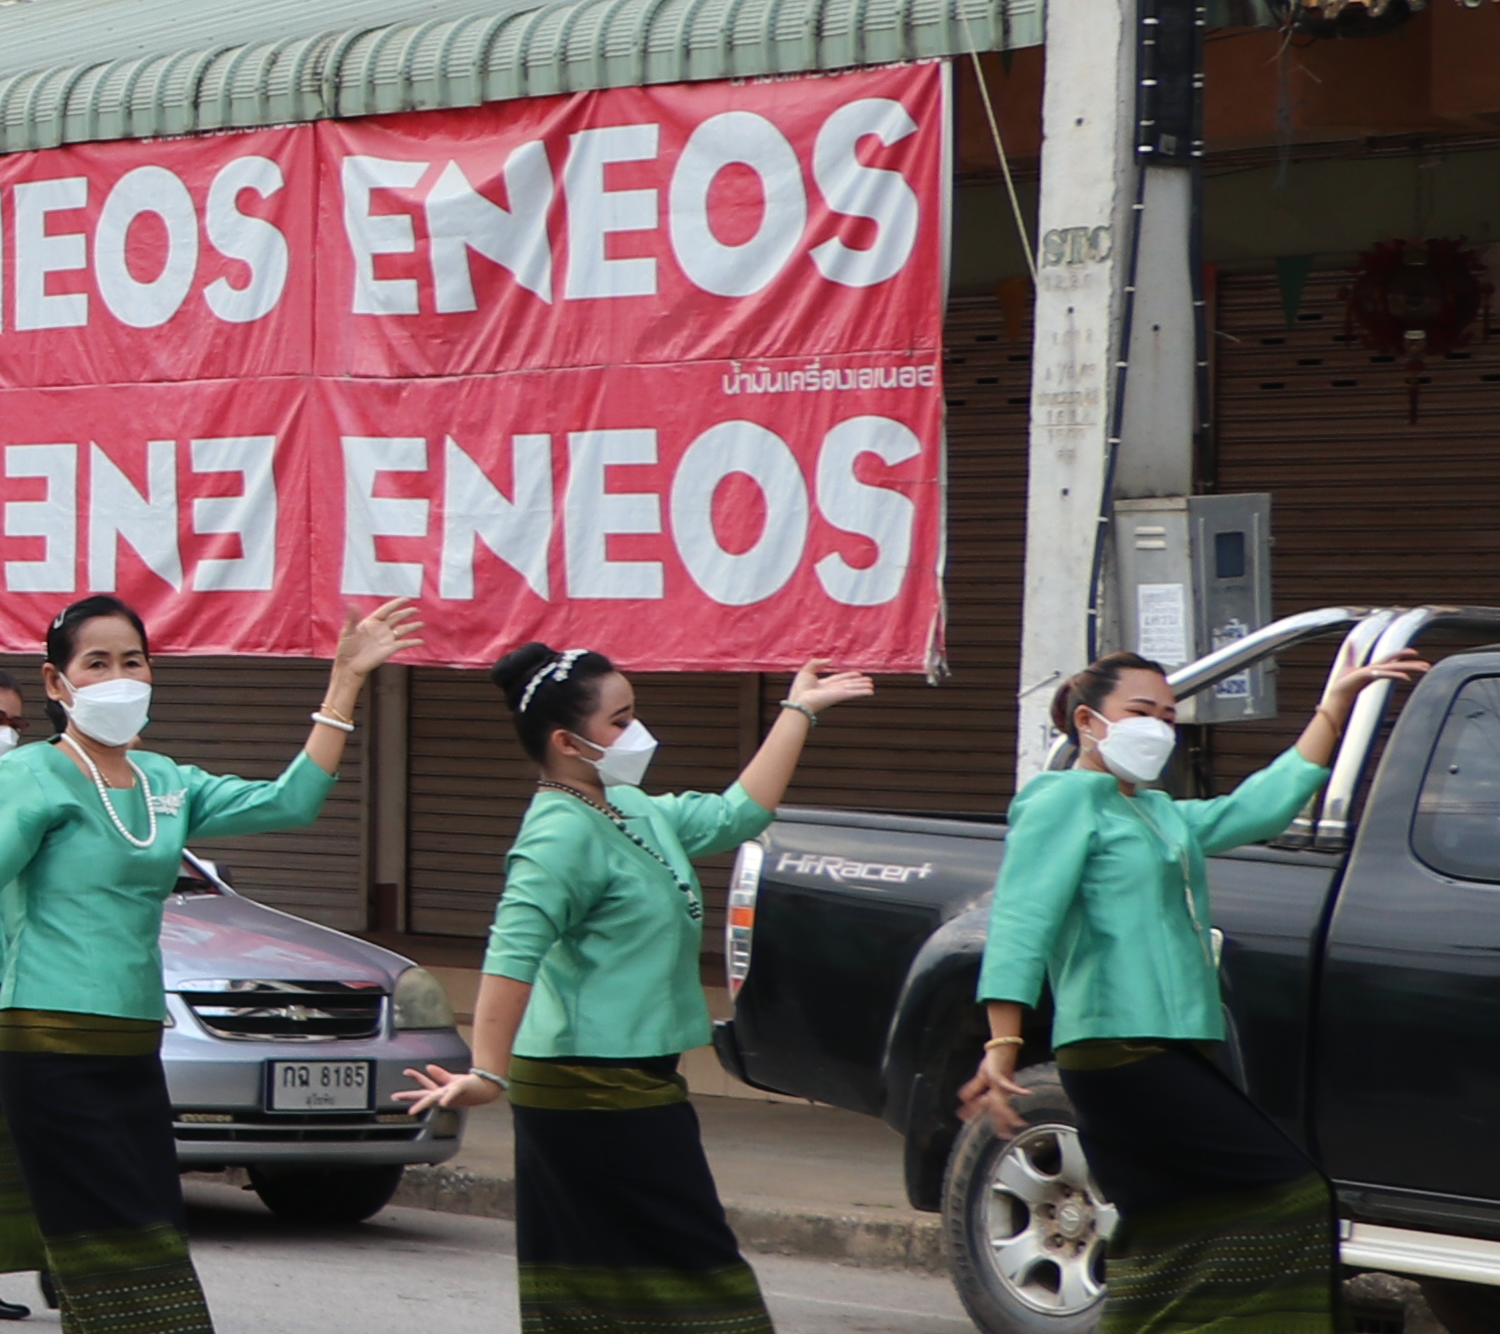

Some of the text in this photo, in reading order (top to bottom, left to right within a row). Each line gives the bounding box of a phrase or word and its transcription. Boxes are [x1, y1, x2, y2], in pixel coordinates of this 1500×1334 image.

[342, 98, 919, 316] ENEOS
[340, 415, 922, 606] ENEOS
[320, 1065, 366, 1088] 8185
